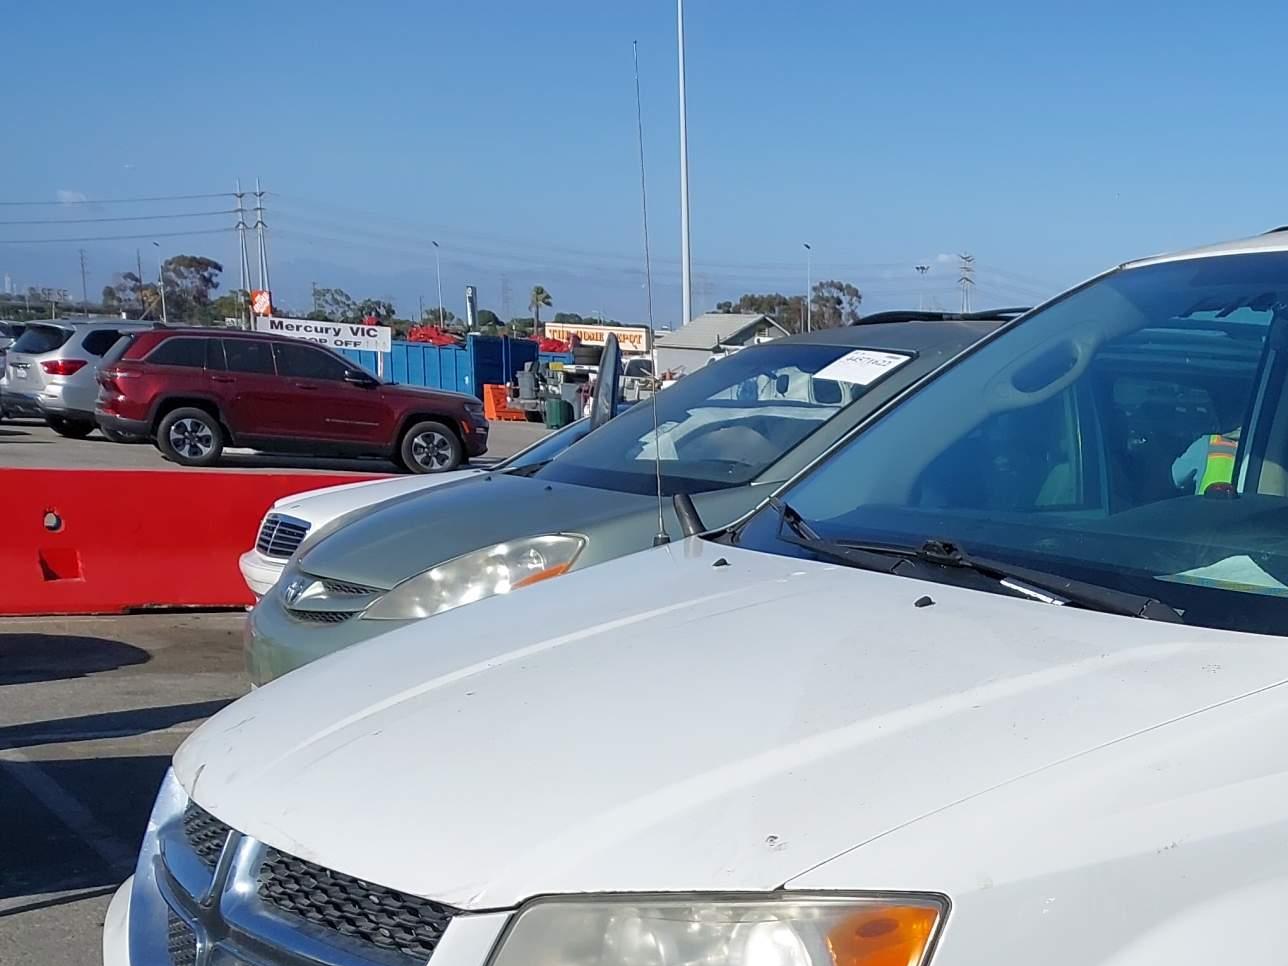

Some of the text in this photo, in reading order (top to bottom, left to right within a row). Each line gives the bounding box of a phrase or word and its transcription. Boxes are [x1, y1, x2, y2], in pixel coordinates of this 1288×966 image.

[270, 320, 378, 338] Mercury VIC
[334, 339, 362, 348] OFF
